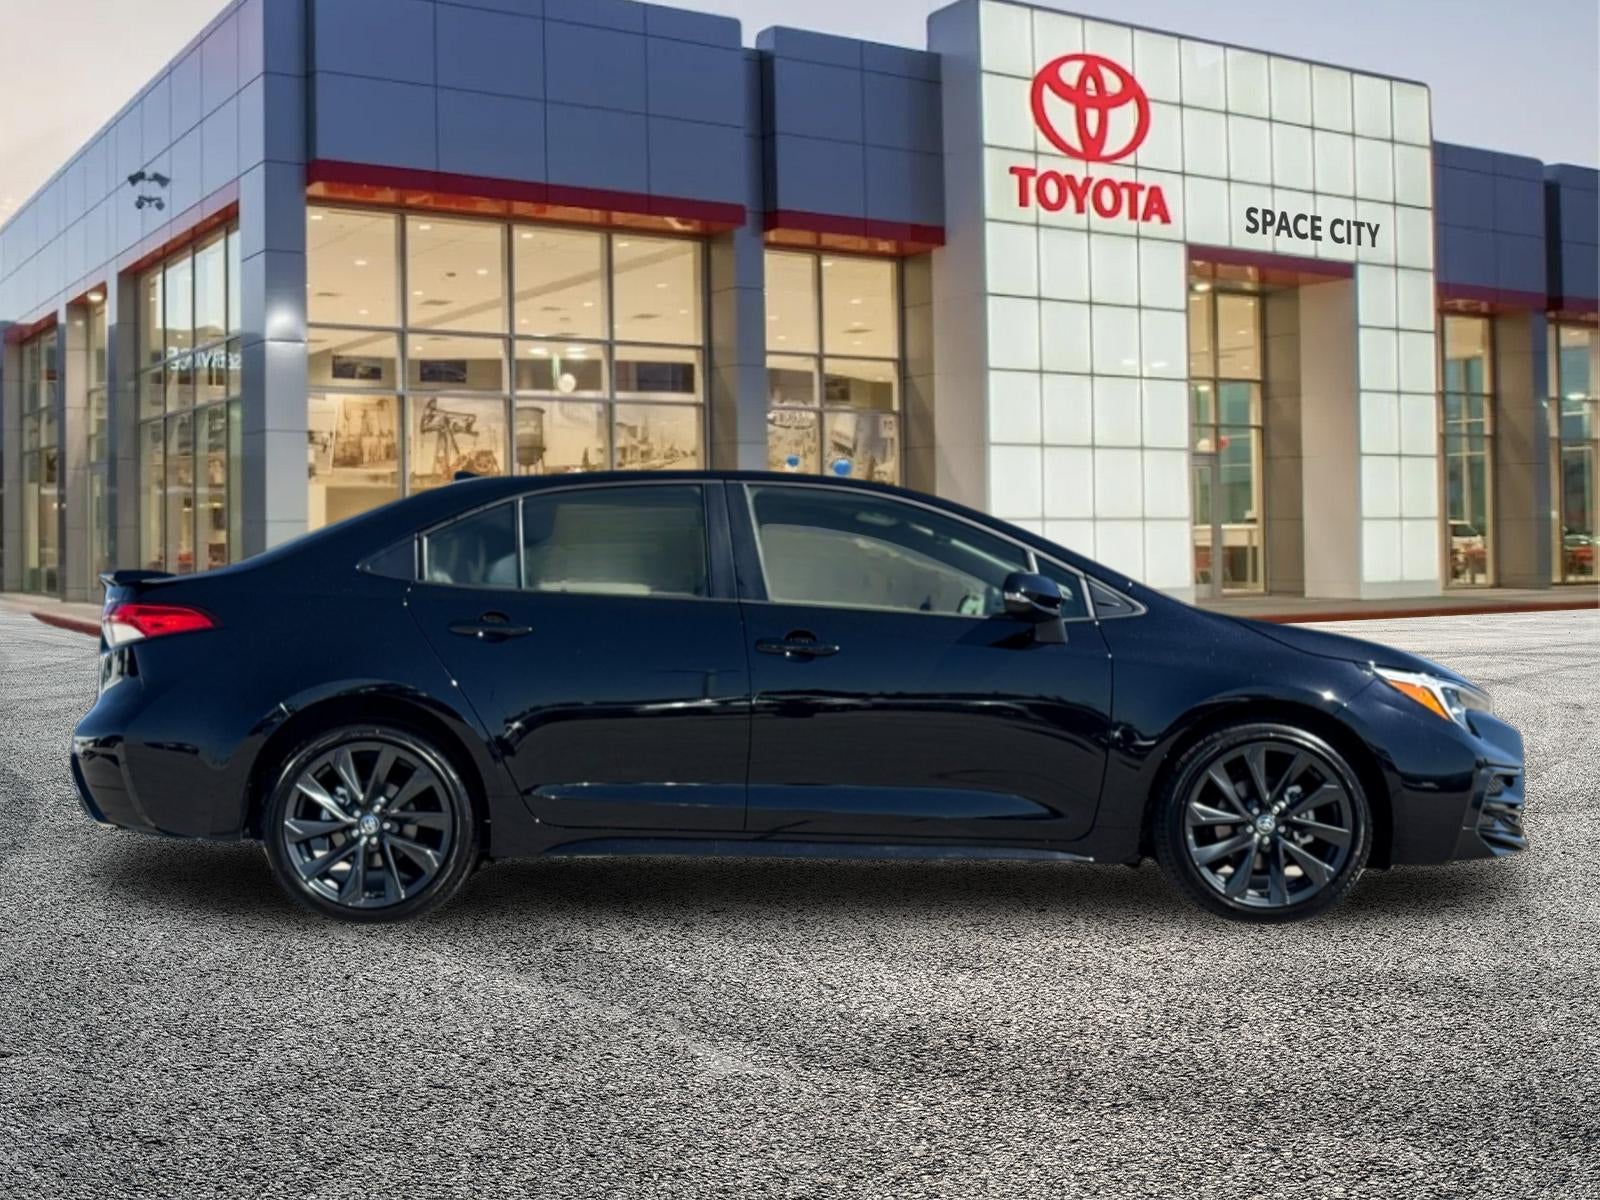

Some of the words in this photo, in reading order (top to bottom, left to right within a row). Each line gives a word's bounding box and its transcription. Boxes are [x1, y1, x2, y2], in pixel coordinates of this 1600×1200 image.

[1010, 167, 1171, 225] TOYOTA
[1246, 206, 1323, 242] SPACE
[1329, 219, 1381, 248] CITY
